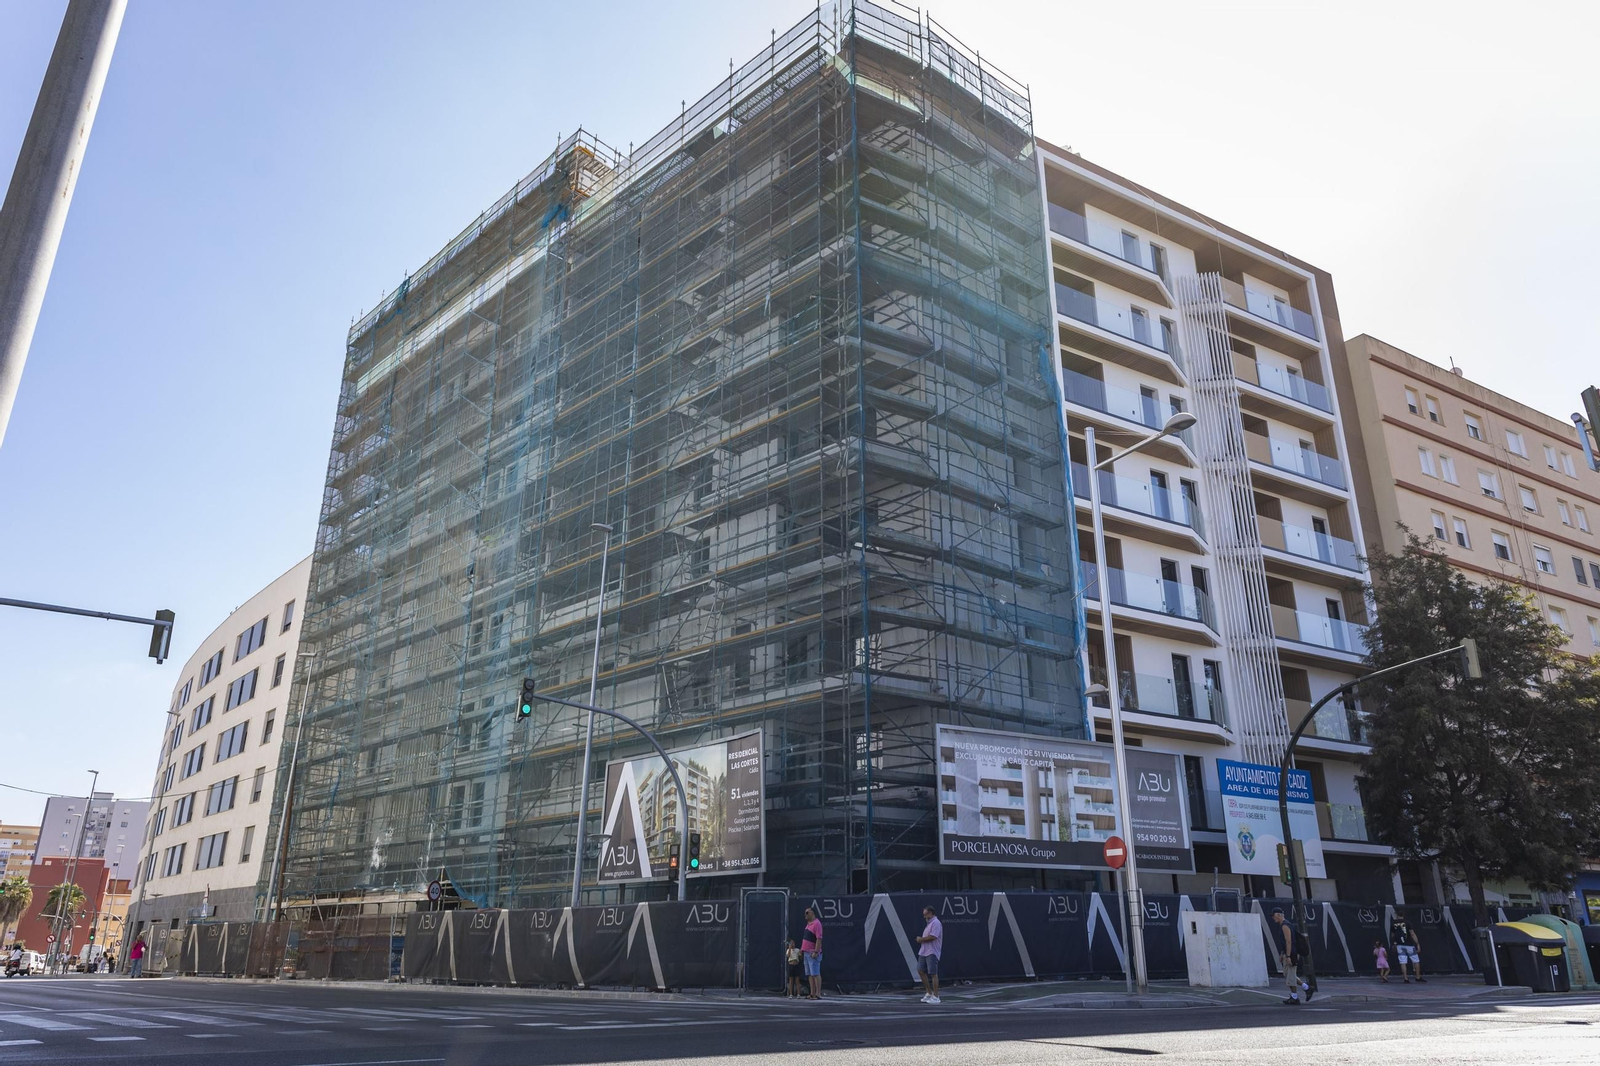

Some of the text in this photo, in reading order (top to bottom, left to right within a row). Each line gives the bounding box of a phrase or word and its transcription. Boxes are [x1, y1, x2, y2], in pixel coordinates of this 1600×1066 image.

[728, 747, 758, 760] RESIDENCIAL
[955, 742, 978, 750] NUEVA
[980, 744, 1022, 755] PROMOCIÓN
[1041, 751, 1075, 760] VIVIENDAS
[955, 752, 996, 762] EXCLUSIVAS
[1009, 756, 1028, 765] CÁDIZ
[1030, 759, 1056, 768] CAPITAL
[741, 758, 758, 768] CORTES
[1139, 772, 1170, 792] ABU
[1226, 766, 1277, 786] AYUNTAMIENTO
[1288, 774, 1307, 790] CADIZ
[731, 788, 741, 799] 51
[1227, 784, 1249, 792] AREA
[1263, 788, 1309, 799] URBNISMO
[606, 846, 635, 866] ABU
[952, 841, 1056, 859] PORCELANOSA Grupo
[686, 904, 729, 923] ABU
[811, 899, 853, 919] ABU
[941, 896, 978, 915] ABU
[1048, 896, 1078, 914] ABU
[418, 914, 436, 929] ABU
[470, 913, 492, 929] ABU
[530, 912, 552, 928] ABU
[597, 908, 624, 926] ABU
